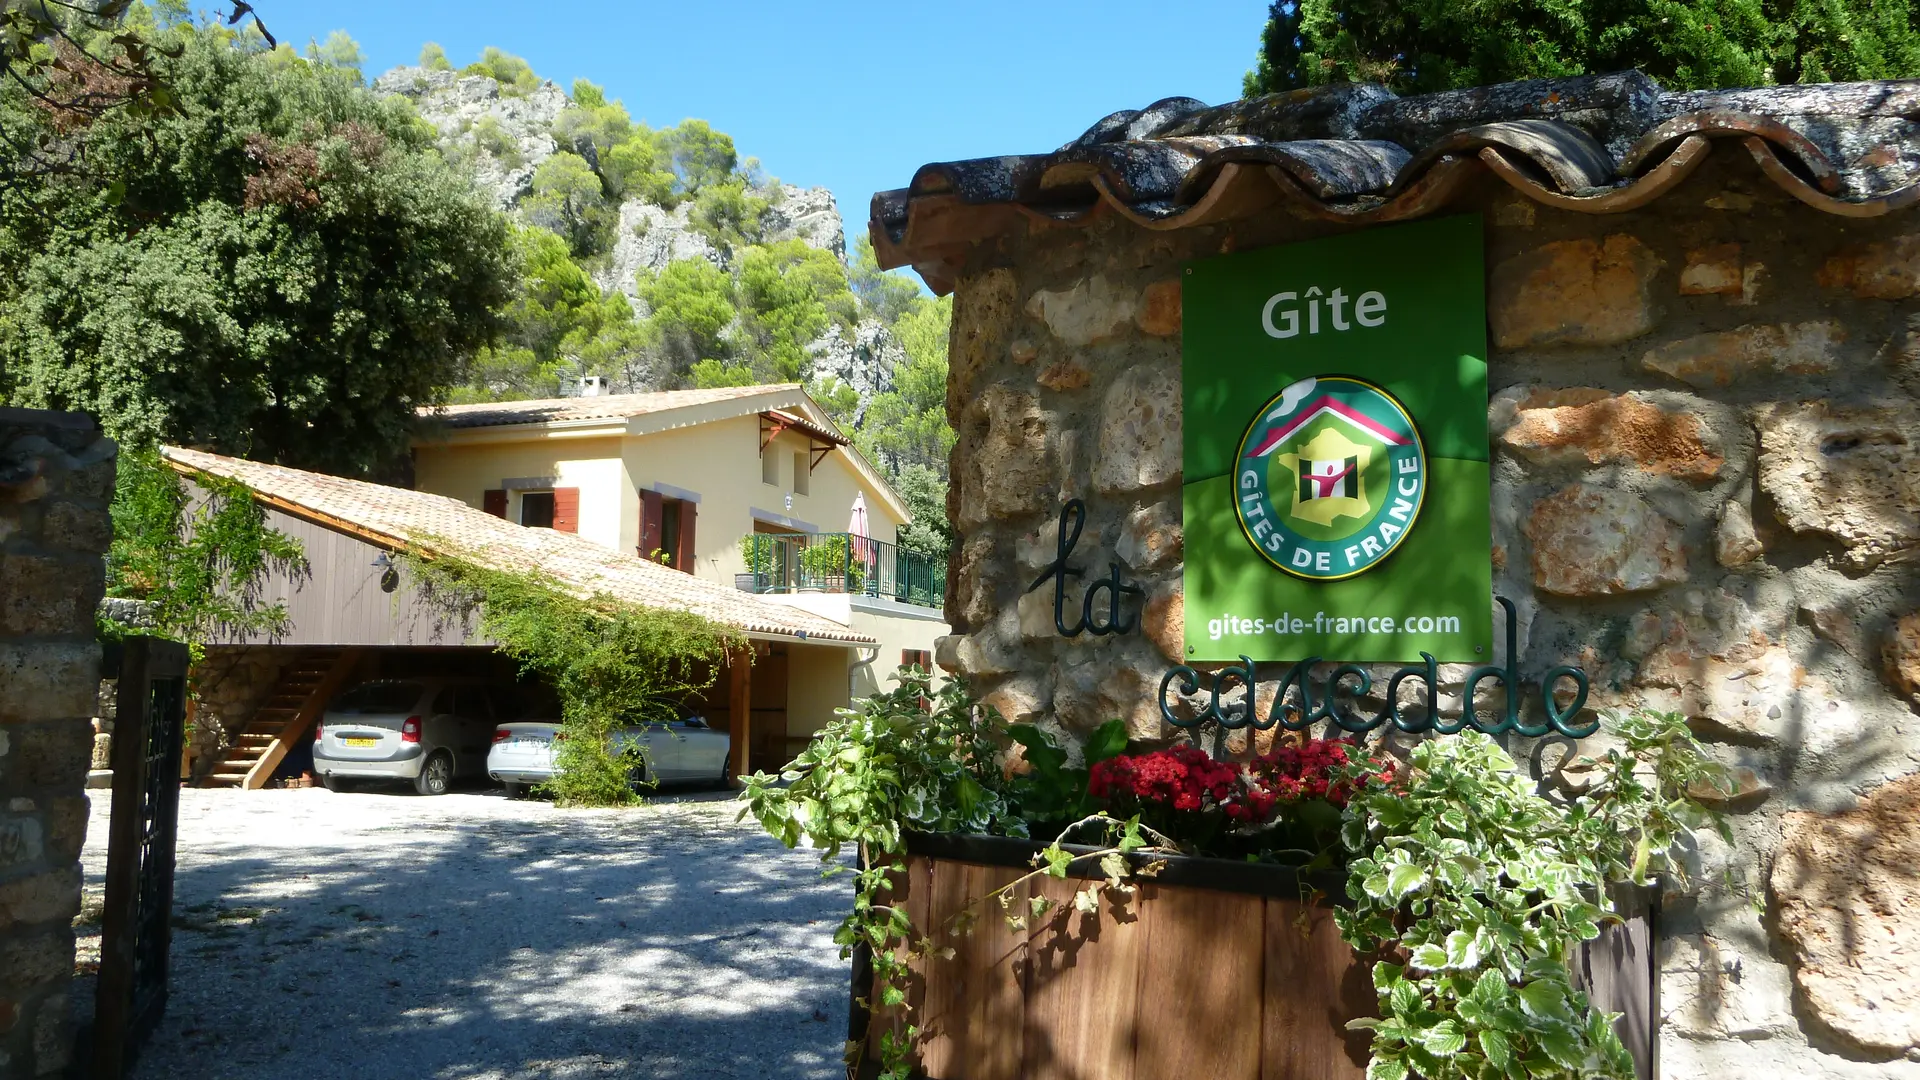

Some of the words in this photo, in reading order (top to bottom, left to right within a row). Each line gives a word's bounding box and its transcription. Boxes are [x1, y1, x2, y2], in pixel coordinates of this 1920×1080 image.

[1261, 286, 1387, 339] Gîte
[1240, 469, 1285, 553] GÎTES
[1291, 547, 1331, 571] DE
[1344, 456, 1418, 567] FRANCE
[1158, 596, 1600, 738] cascade
[1208, 611, 1460, 641] gites-de-france.com
